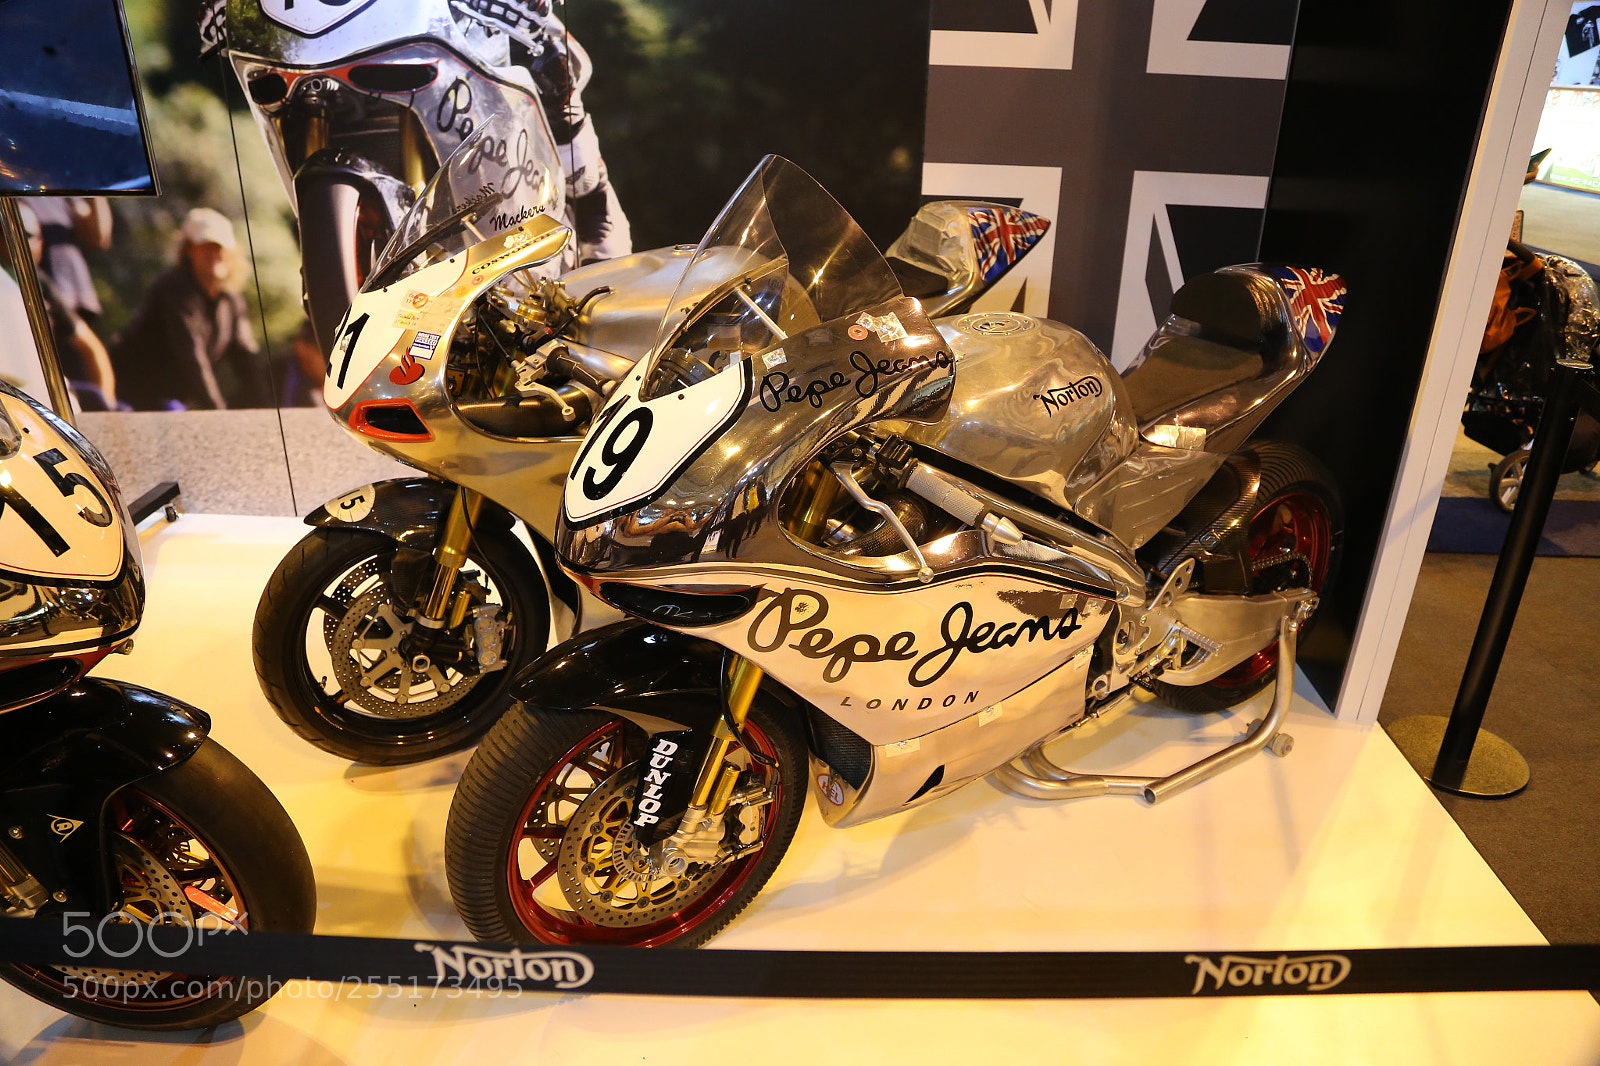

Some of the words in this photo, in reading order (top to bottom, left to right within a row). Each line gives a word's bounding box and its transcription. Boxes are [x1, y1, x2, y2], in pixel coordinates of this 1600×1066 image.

[490, 203, 546, 231] Mackers
[760, 371, 851, 413] Pepe
[850, 350, 954, 398] Jeans
[1033, 376, 1102, 418] Norton
[570, 394, 653, 500] 19
[747, 588, 919, 683] Pepe
[908, 601, 1082, 688] Jeans
[840, 691, 979, 711] LONDON
[633, 739, 678, 827] DUNLOP
[414, 942, 594, 989] Norton
[1184, 954, 1351, 995] Norton
